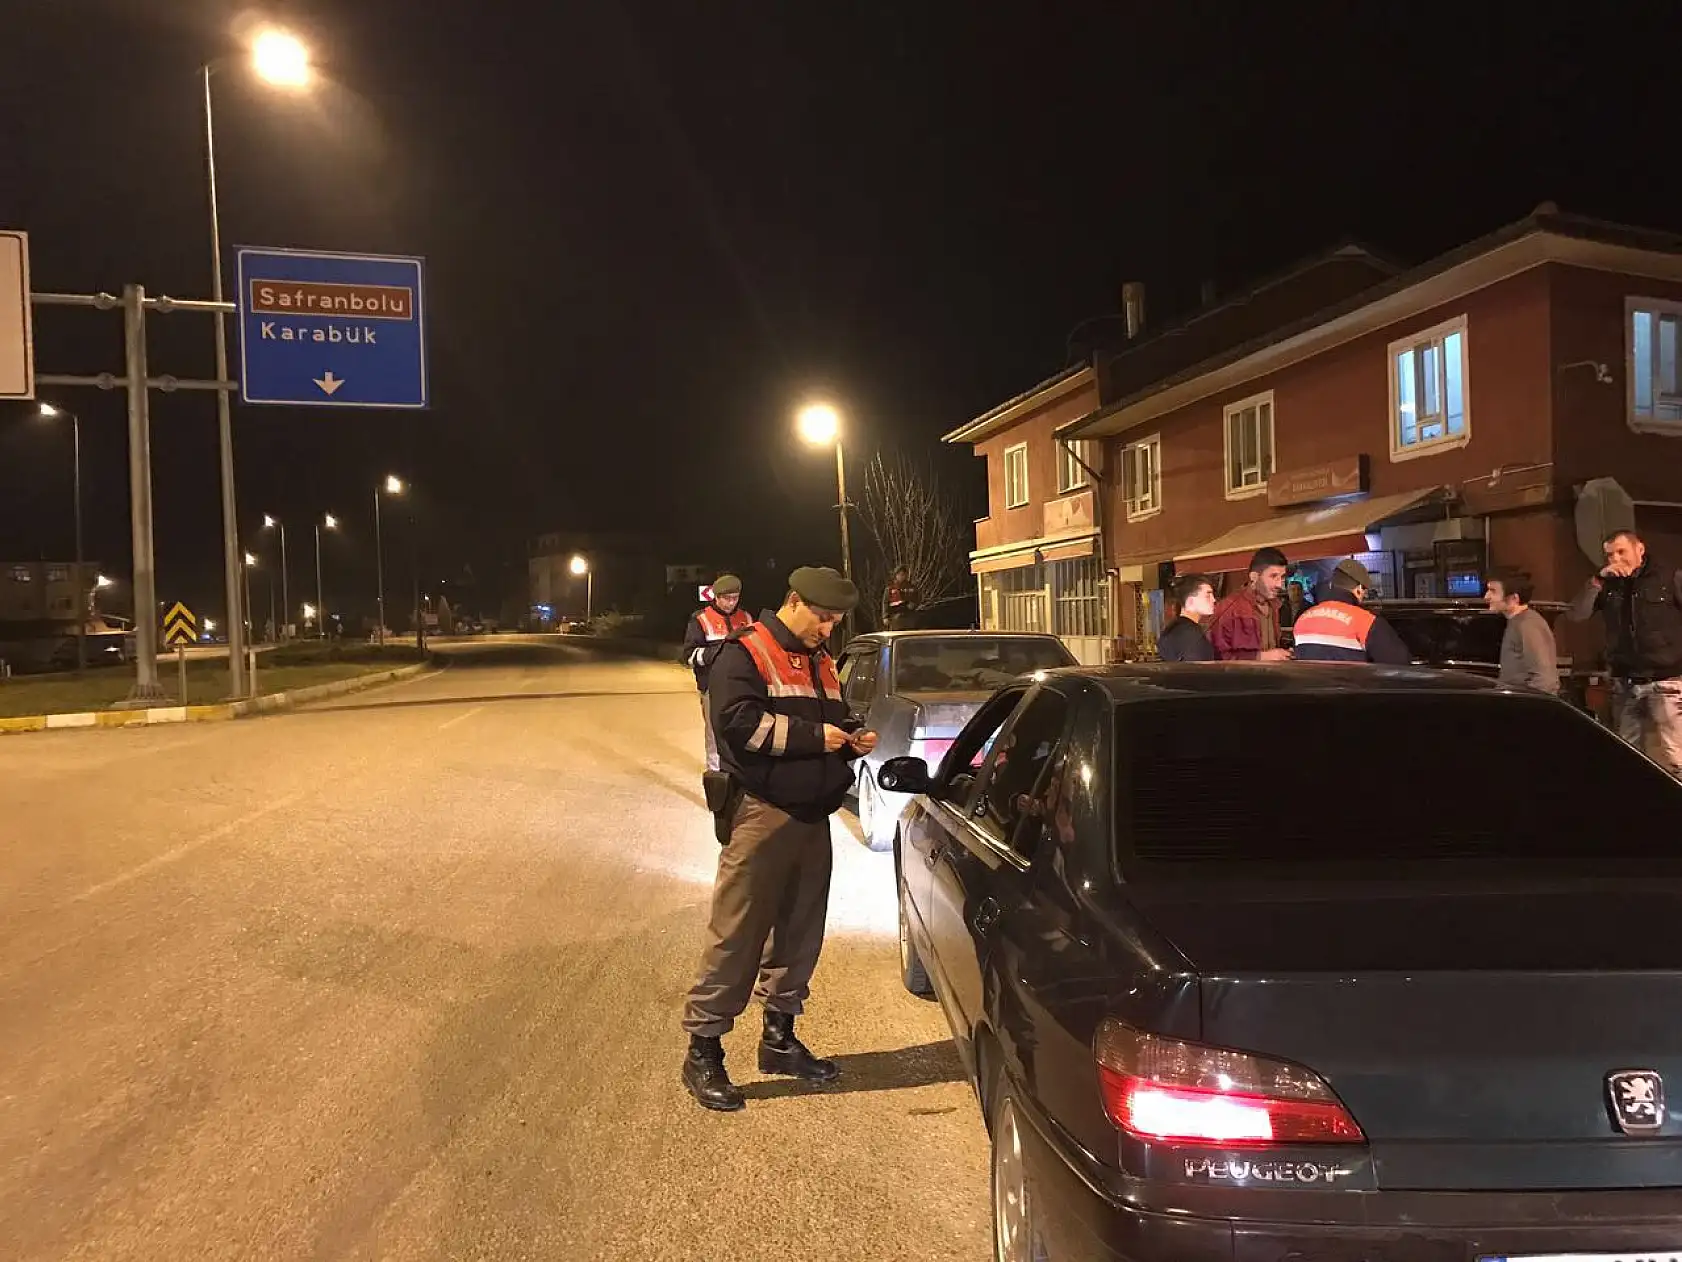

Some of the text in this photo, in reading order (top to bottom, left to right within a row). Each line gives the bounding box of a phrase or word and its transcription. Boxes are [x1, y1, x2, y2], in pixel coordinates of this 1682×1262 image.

[259, 287, 404, 312] Safranbolu
[261, 321, 377, 344] Karabük
[1184, 1156, 1342, 1183] PEUGEOT
